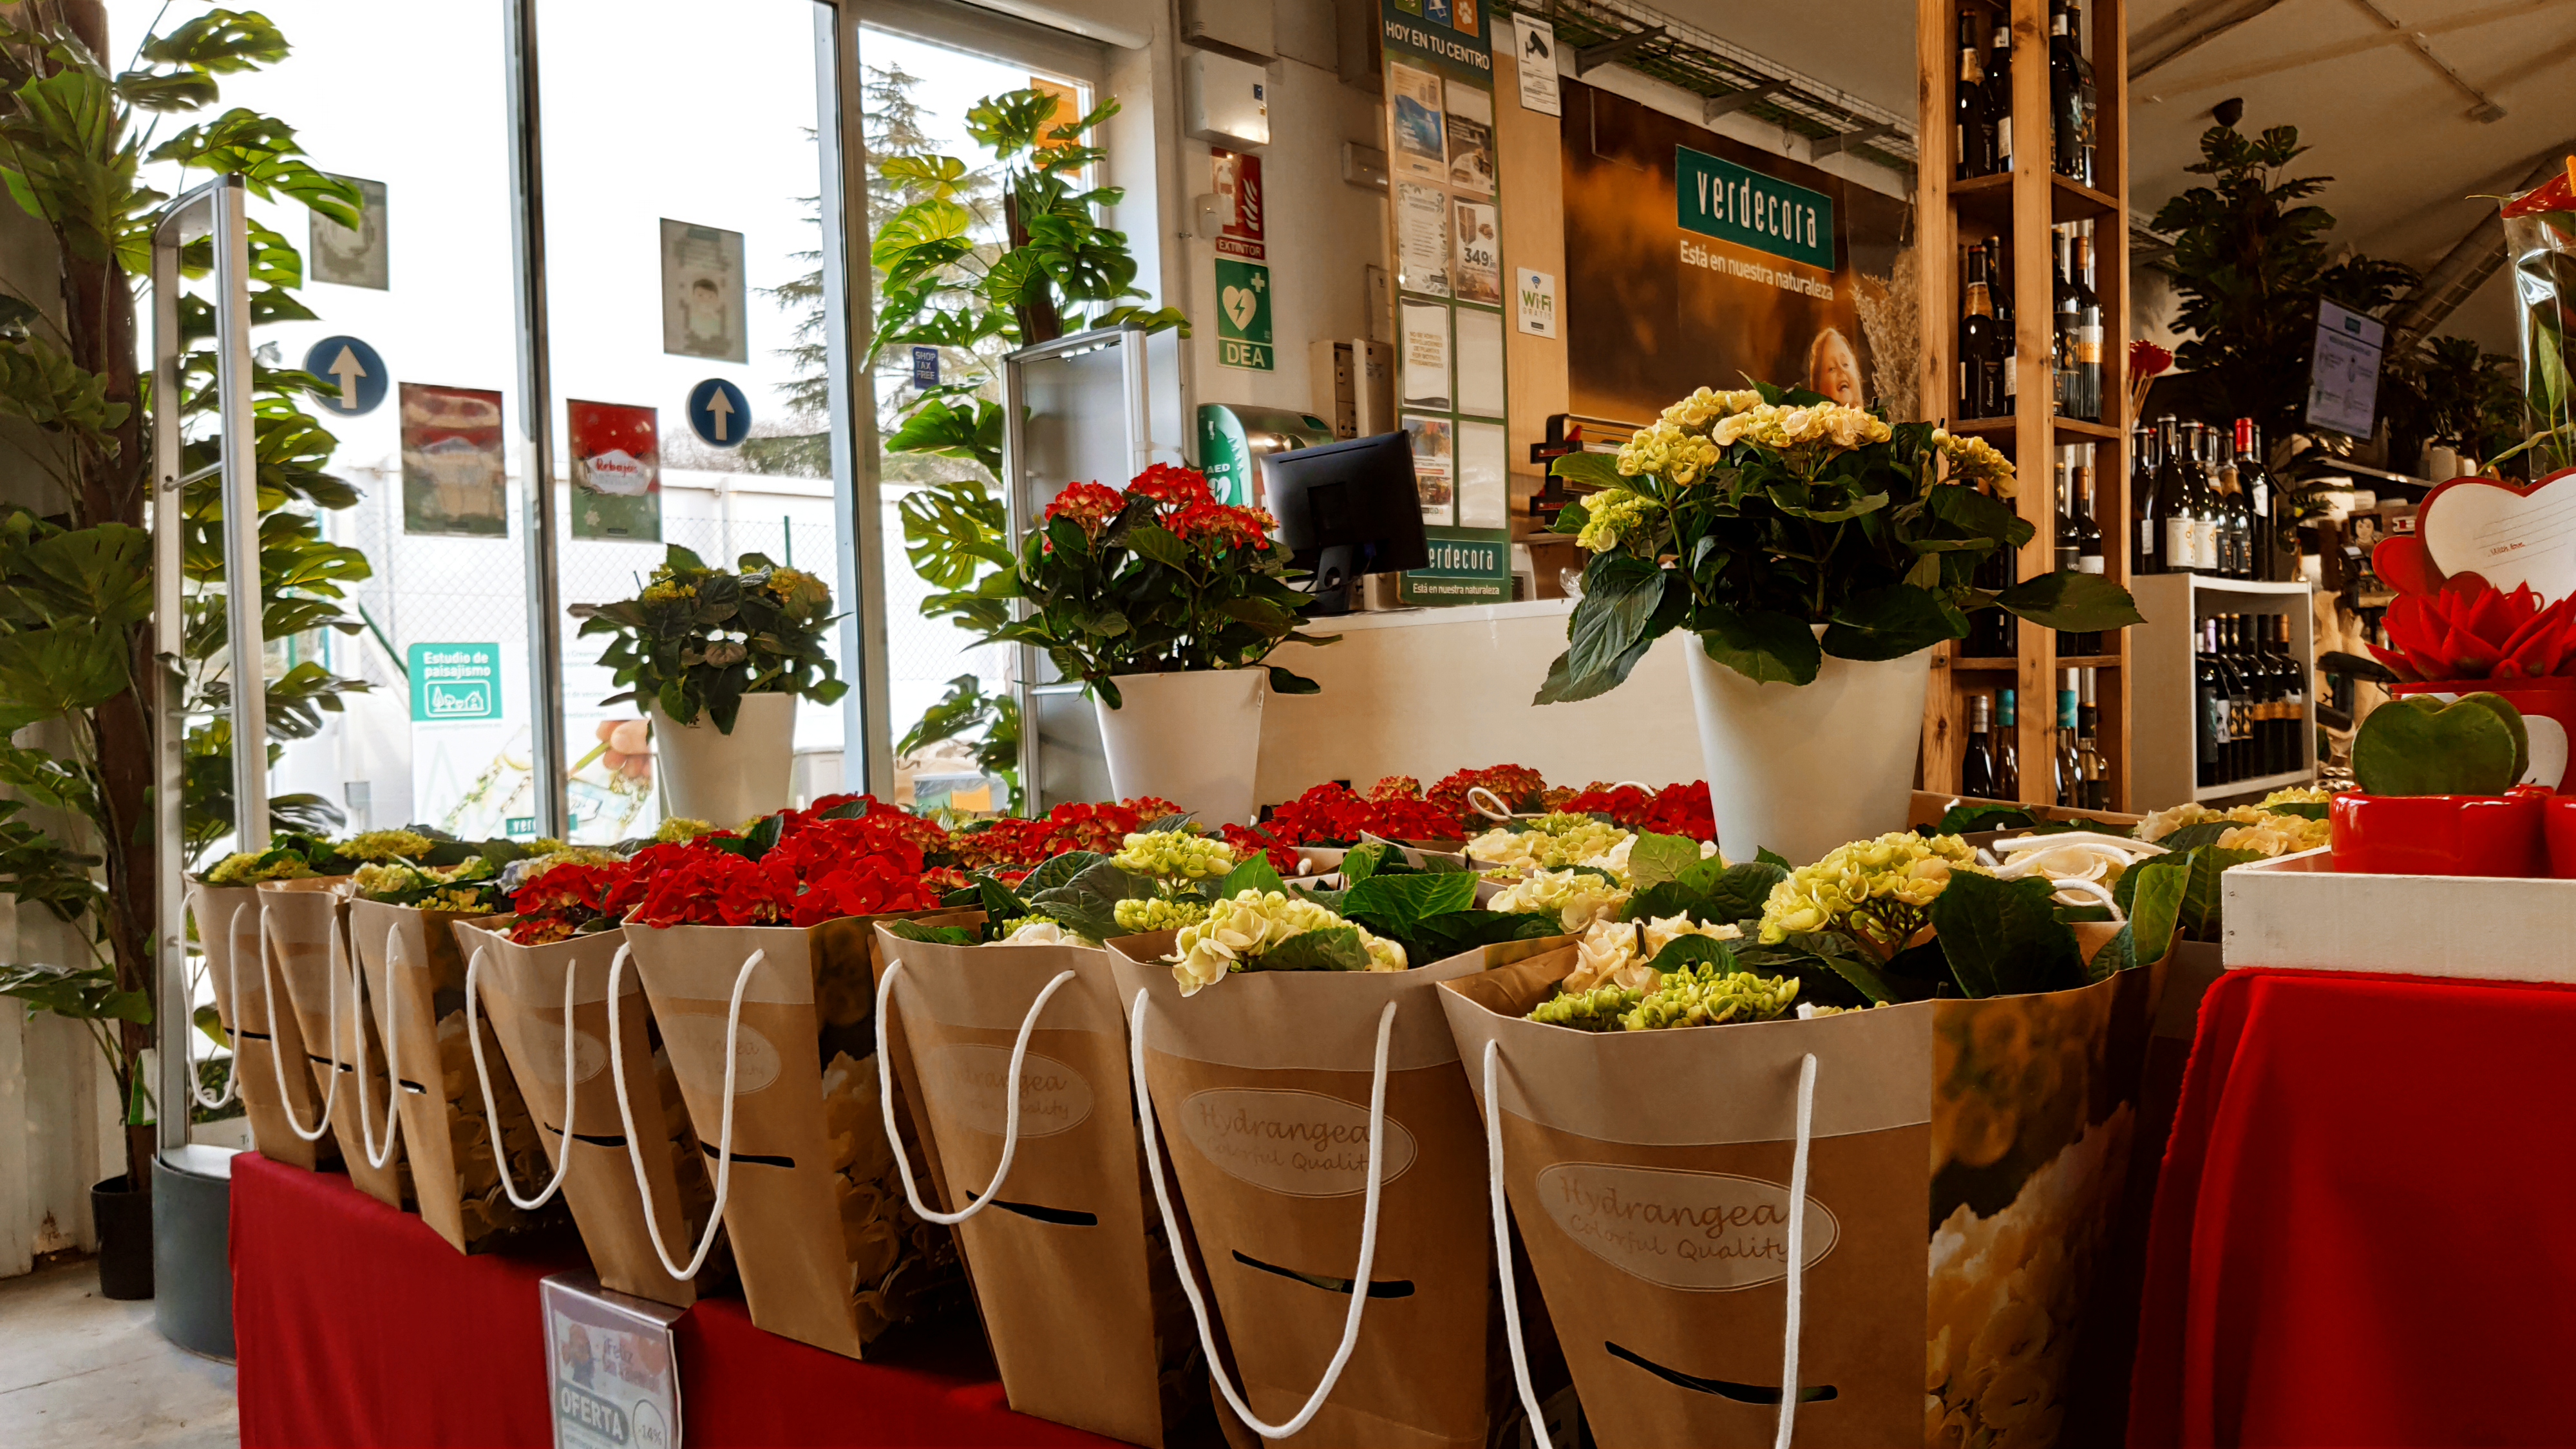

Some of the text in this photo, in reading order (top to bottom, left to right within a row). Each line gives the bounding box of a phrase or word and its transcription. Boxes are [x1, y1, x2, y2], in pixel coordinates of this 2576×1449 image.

[1386, 21, 1490, 70] HOY EN TU CENTRO
[1697, 171, 1817, 249] verdecora
[1218, 240, 1262, 258] EXTINTOR
[1680, 240, 1834, 301] Está en nuestra naturaleza
[915, 351, 936, 361] SHOP
[916, 361, 931, 370] TAX
[1226, 343, 1265, 368] DEA
[916, 370, 936, 380] FREE
[1206, 463, 1231, 475] AED
[1429, 544, 1493, 571] erdecora
[1412, 582, 1500, 595] Está en nuestra naturaleza
[423, 650, 489, 665] Estudio de
[424, 665, 491, 680] paisajismo
[1200, 1103, 1370, 1152] Hydrangea
[1292, 1151, 1368, 1173] Qualit
[1560, 1176, 1791, 1240] Hydrangea
[1570, 1213, 1667, 1256] Colorful
[561, 1387, 623, 1441] OFERTA
